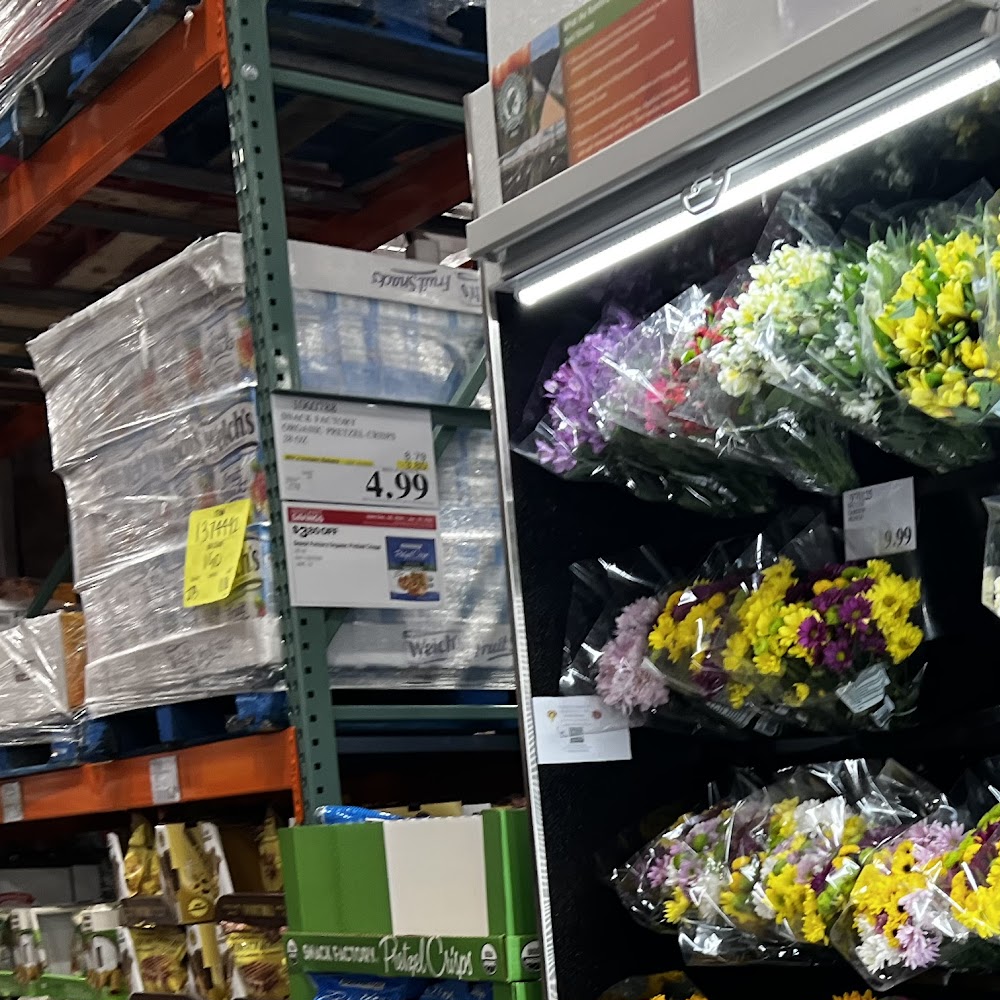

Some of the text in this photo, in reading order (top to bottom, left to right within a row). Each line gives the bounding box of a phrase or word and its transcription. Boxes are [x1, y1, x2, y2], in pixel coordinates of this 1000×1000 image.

[370, 270, 416, 292] Snacks
[366, 470, 429, 501] 4.99
[885, 526, 912, 549] 9.99
[378, 935, 426, 977] Pretzel
[426, 935, 473, 980] Crisps
